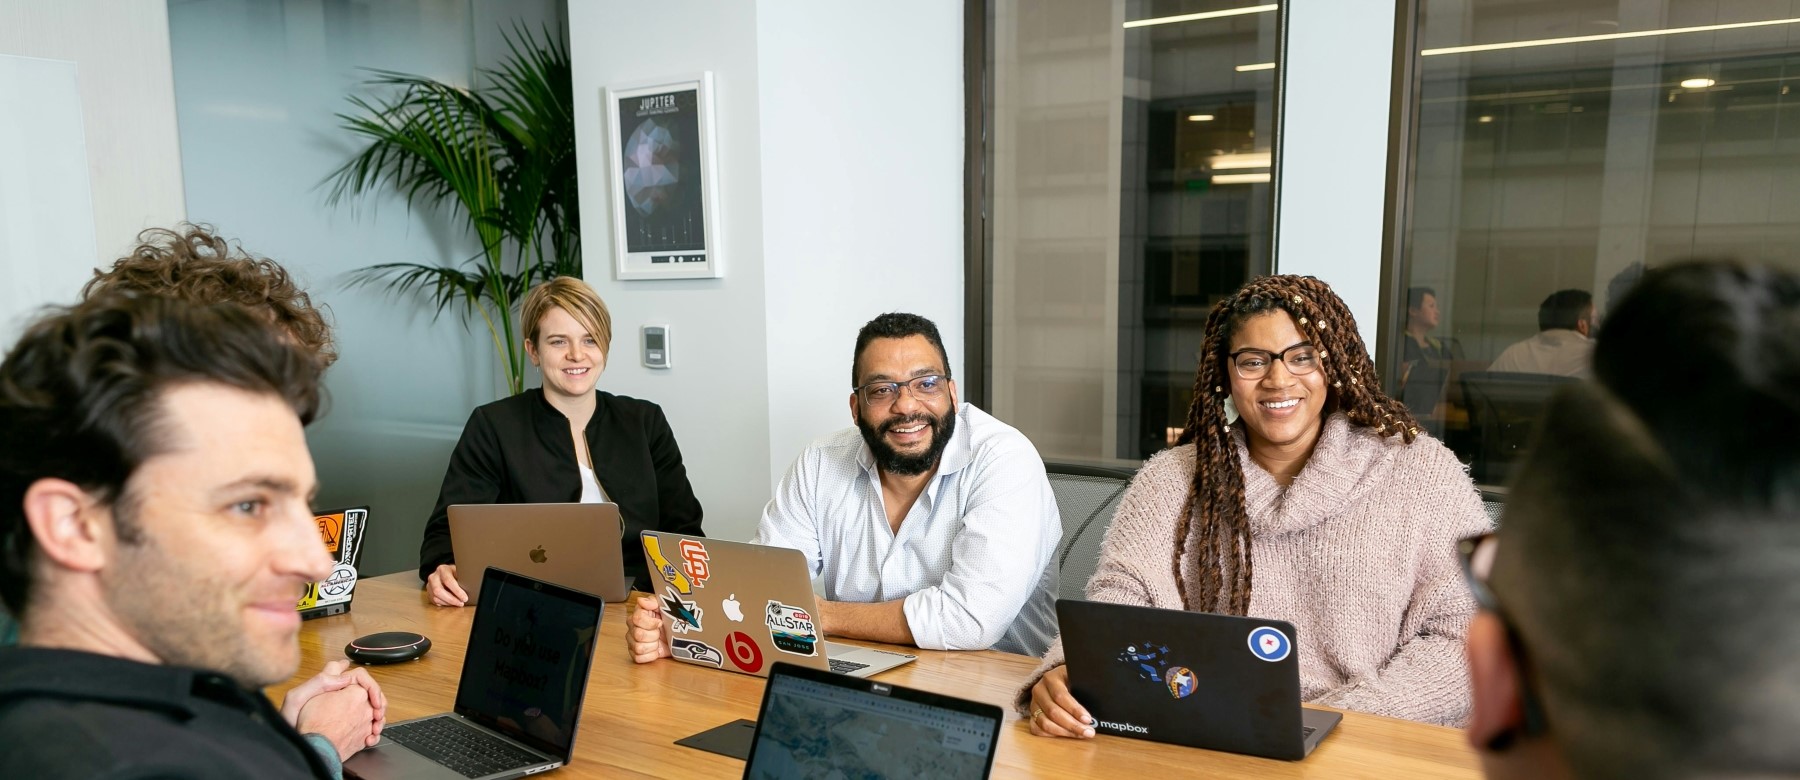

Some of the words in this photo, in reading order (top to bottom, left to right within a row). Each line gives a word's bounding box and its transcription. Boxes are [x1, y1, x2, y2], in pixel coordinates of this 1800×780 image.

[640, 94, 675, 110] JUPITER
[495, 627, 511, 647] Do
[539, 645, 561, 665] use
[1101, 721, 1148, 733] mapbox
